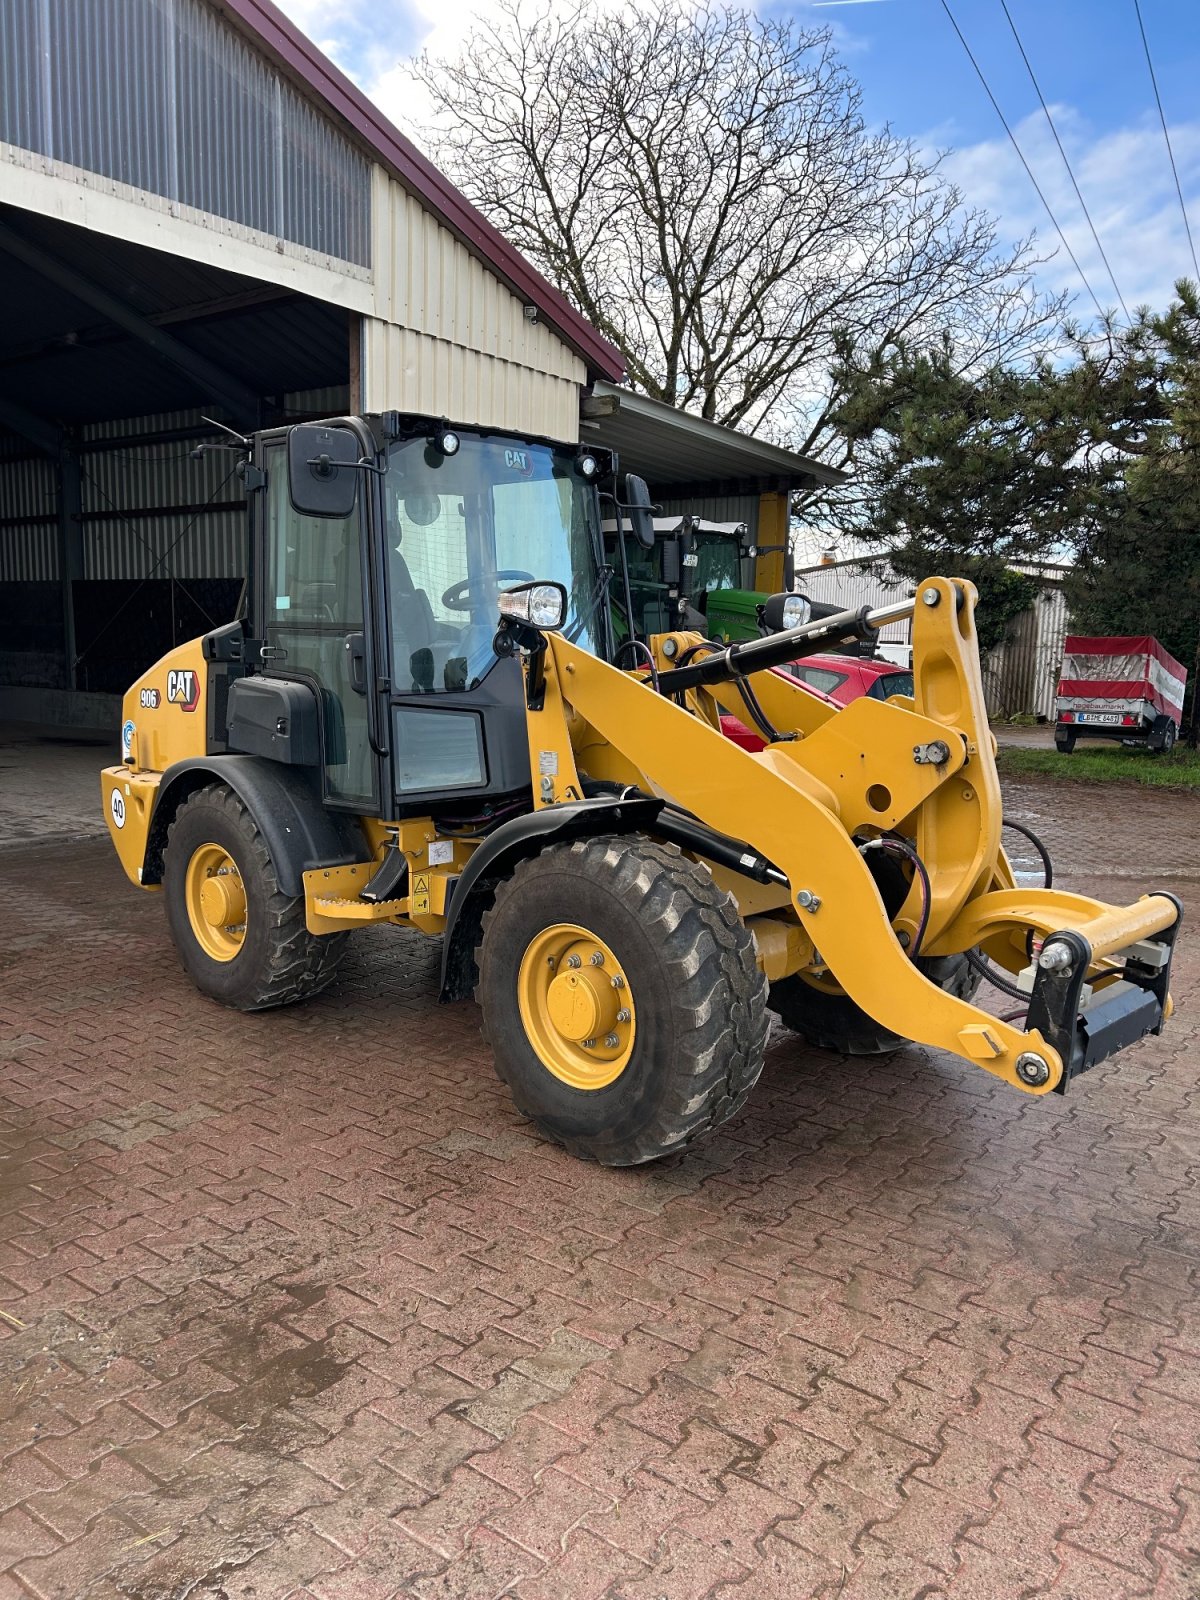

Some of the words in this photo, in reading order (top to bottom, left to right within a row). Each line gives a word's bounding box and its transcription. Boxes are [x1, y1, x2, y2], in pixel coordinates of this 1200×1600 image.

[504, 449, 526, 469] CAT
[168, 670, 193, 703] CAT
[140, 688, 157, 709] 906
[113, 797, 124, 819] 40
